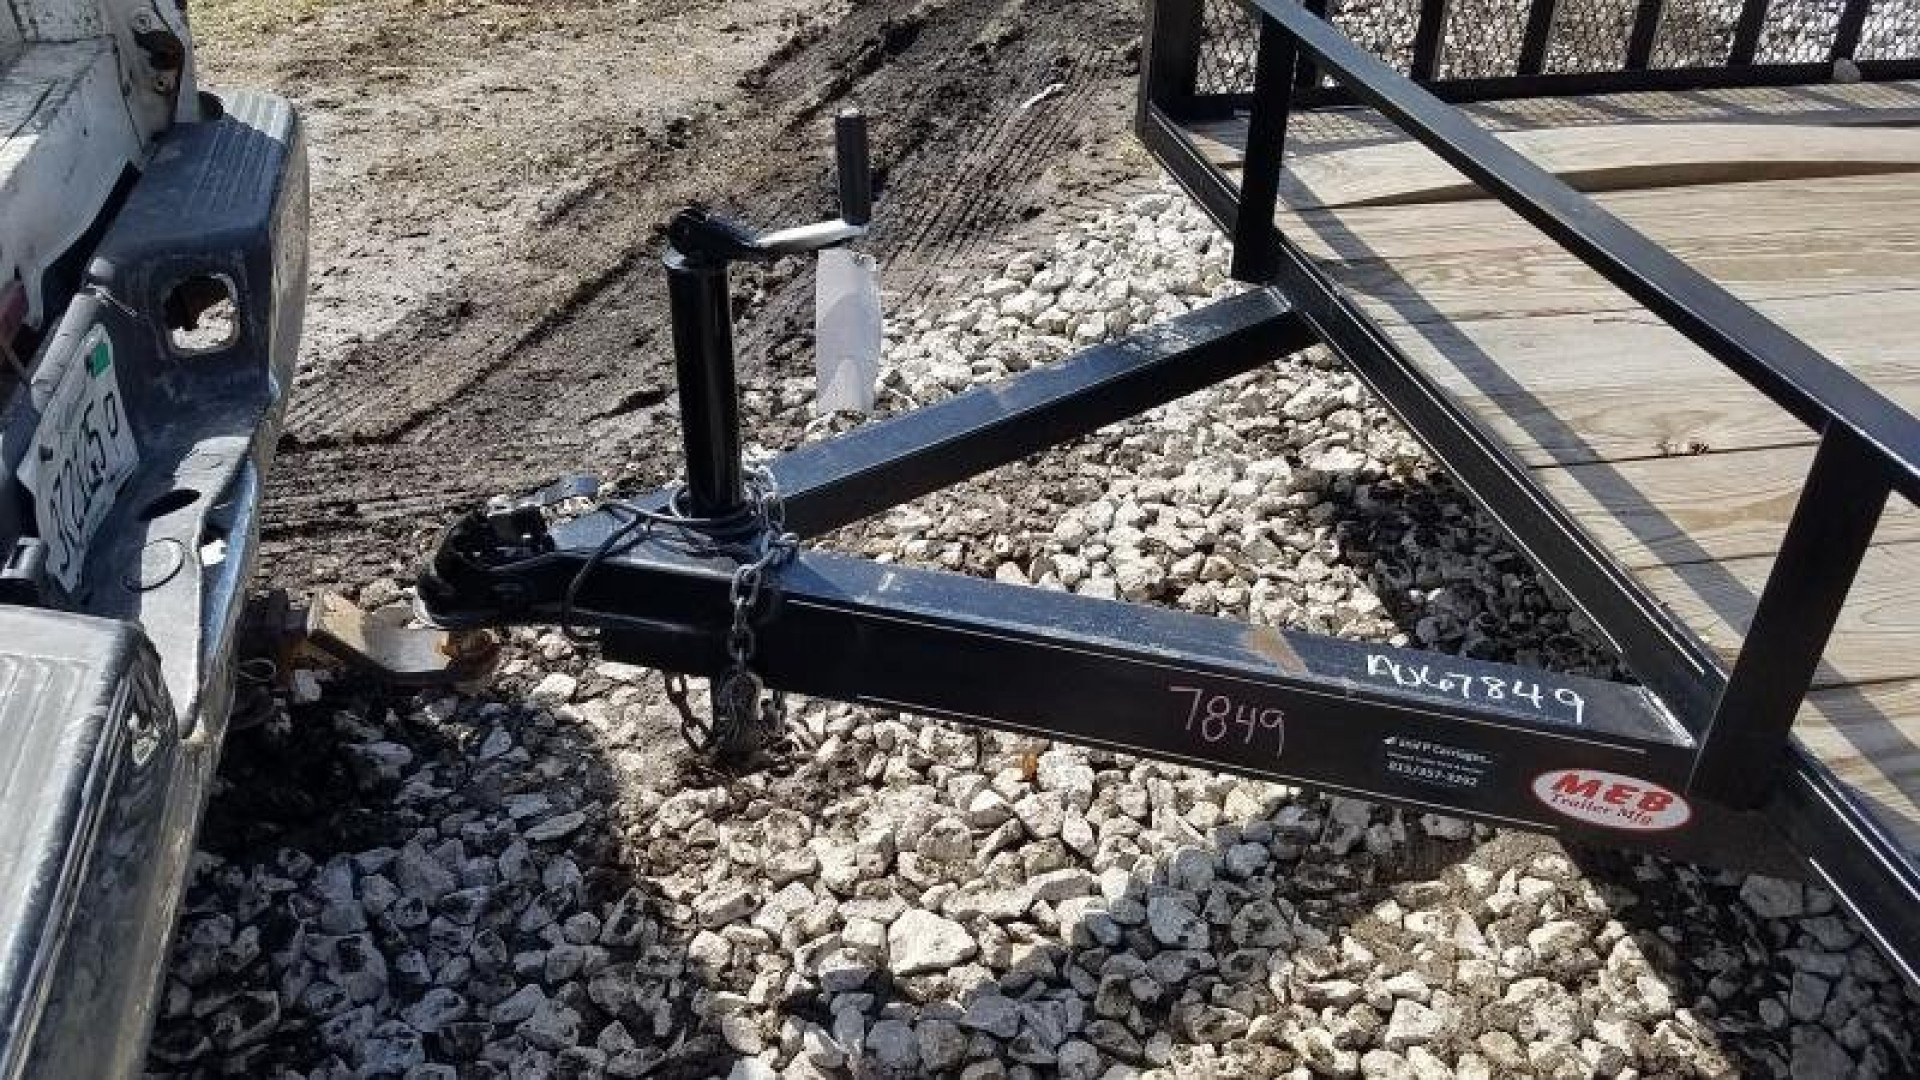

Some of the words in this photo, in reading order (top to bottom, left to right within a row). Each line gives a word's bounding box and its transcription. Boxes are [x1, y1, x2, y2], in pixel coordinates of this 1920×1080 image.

[1169, 686, 1285, 759] 7849
[1550, 772, 1674, 812] MEB
[1552, 793, 1609, 815] Trailer
